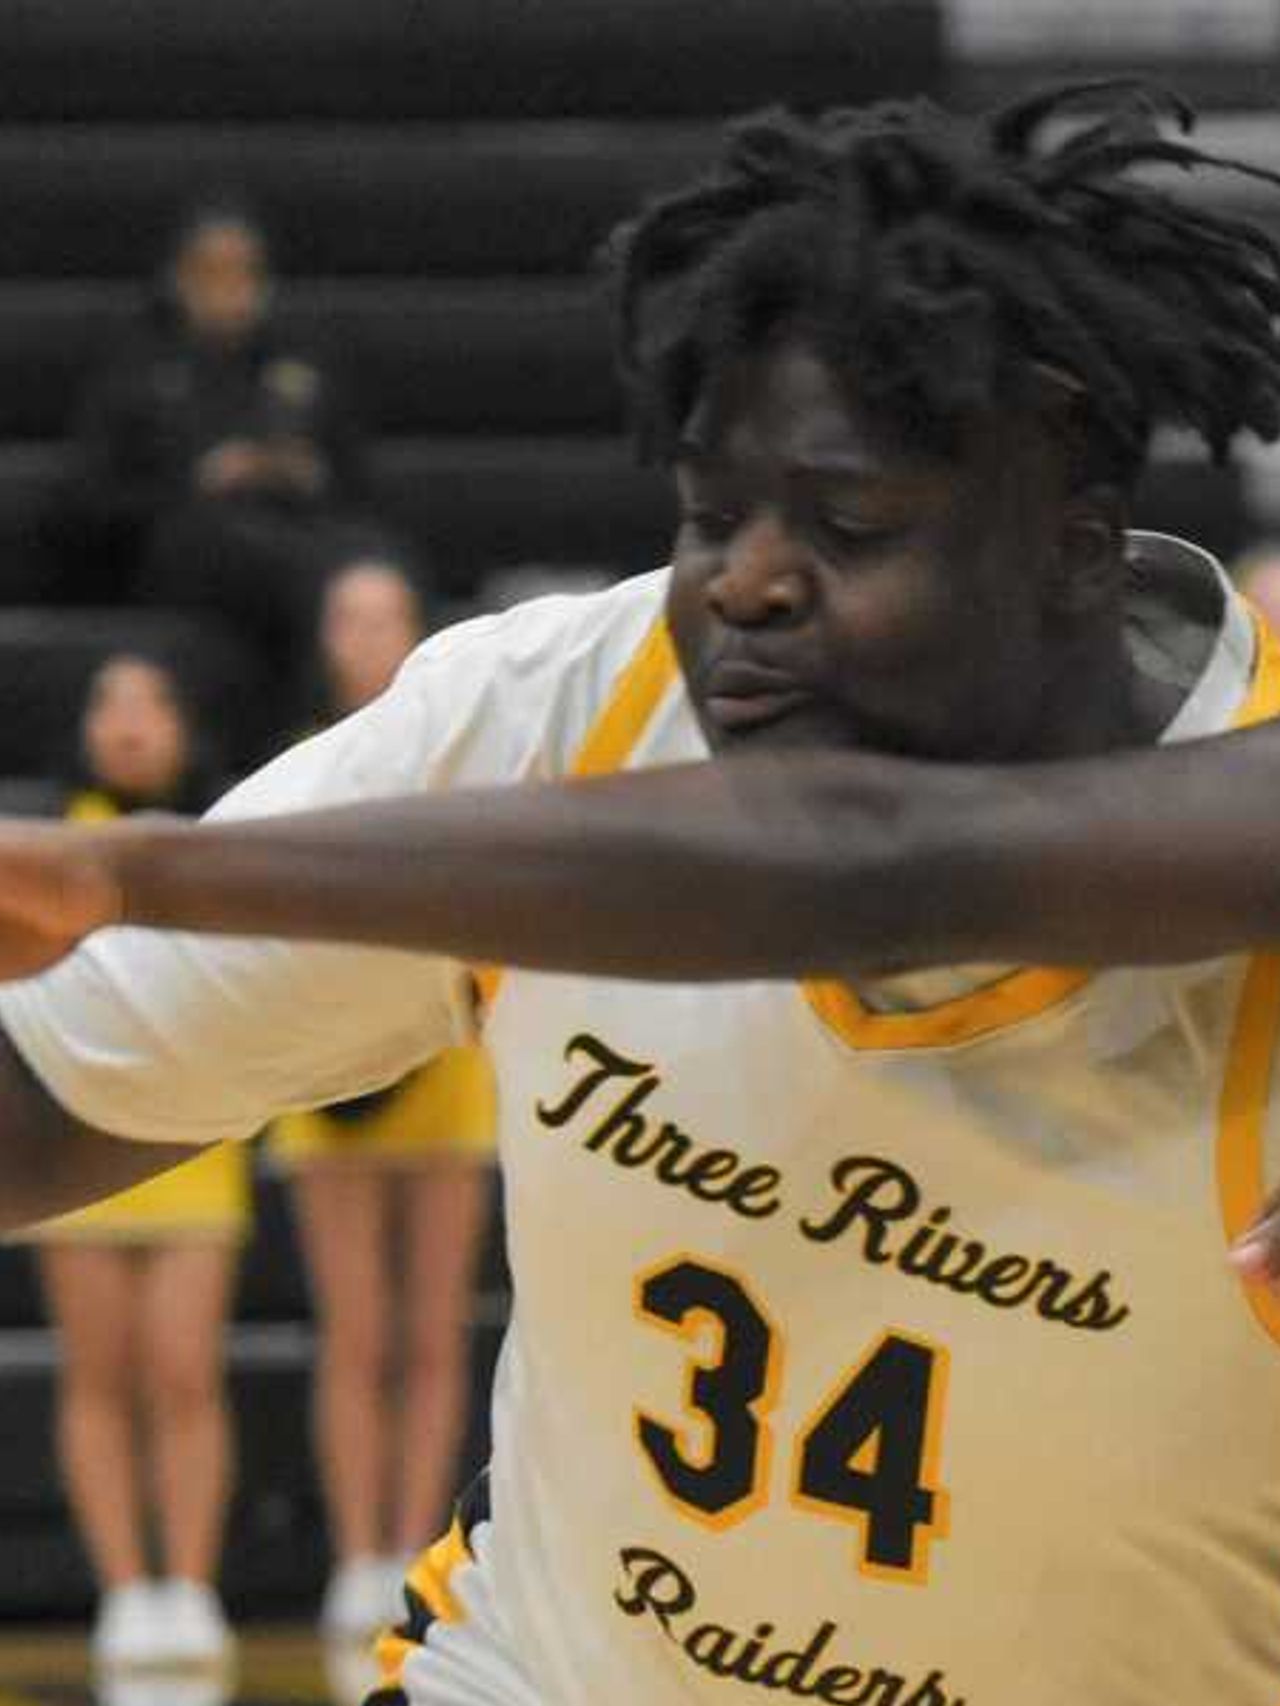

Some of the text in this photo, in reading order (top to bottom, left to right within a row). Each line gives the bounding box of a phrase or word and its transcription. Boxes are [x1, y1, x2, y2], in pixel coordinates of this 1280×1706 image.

[536, 1033, 1130, 1332] Three Rivers
[633, 1254, 946, 1580] 34
